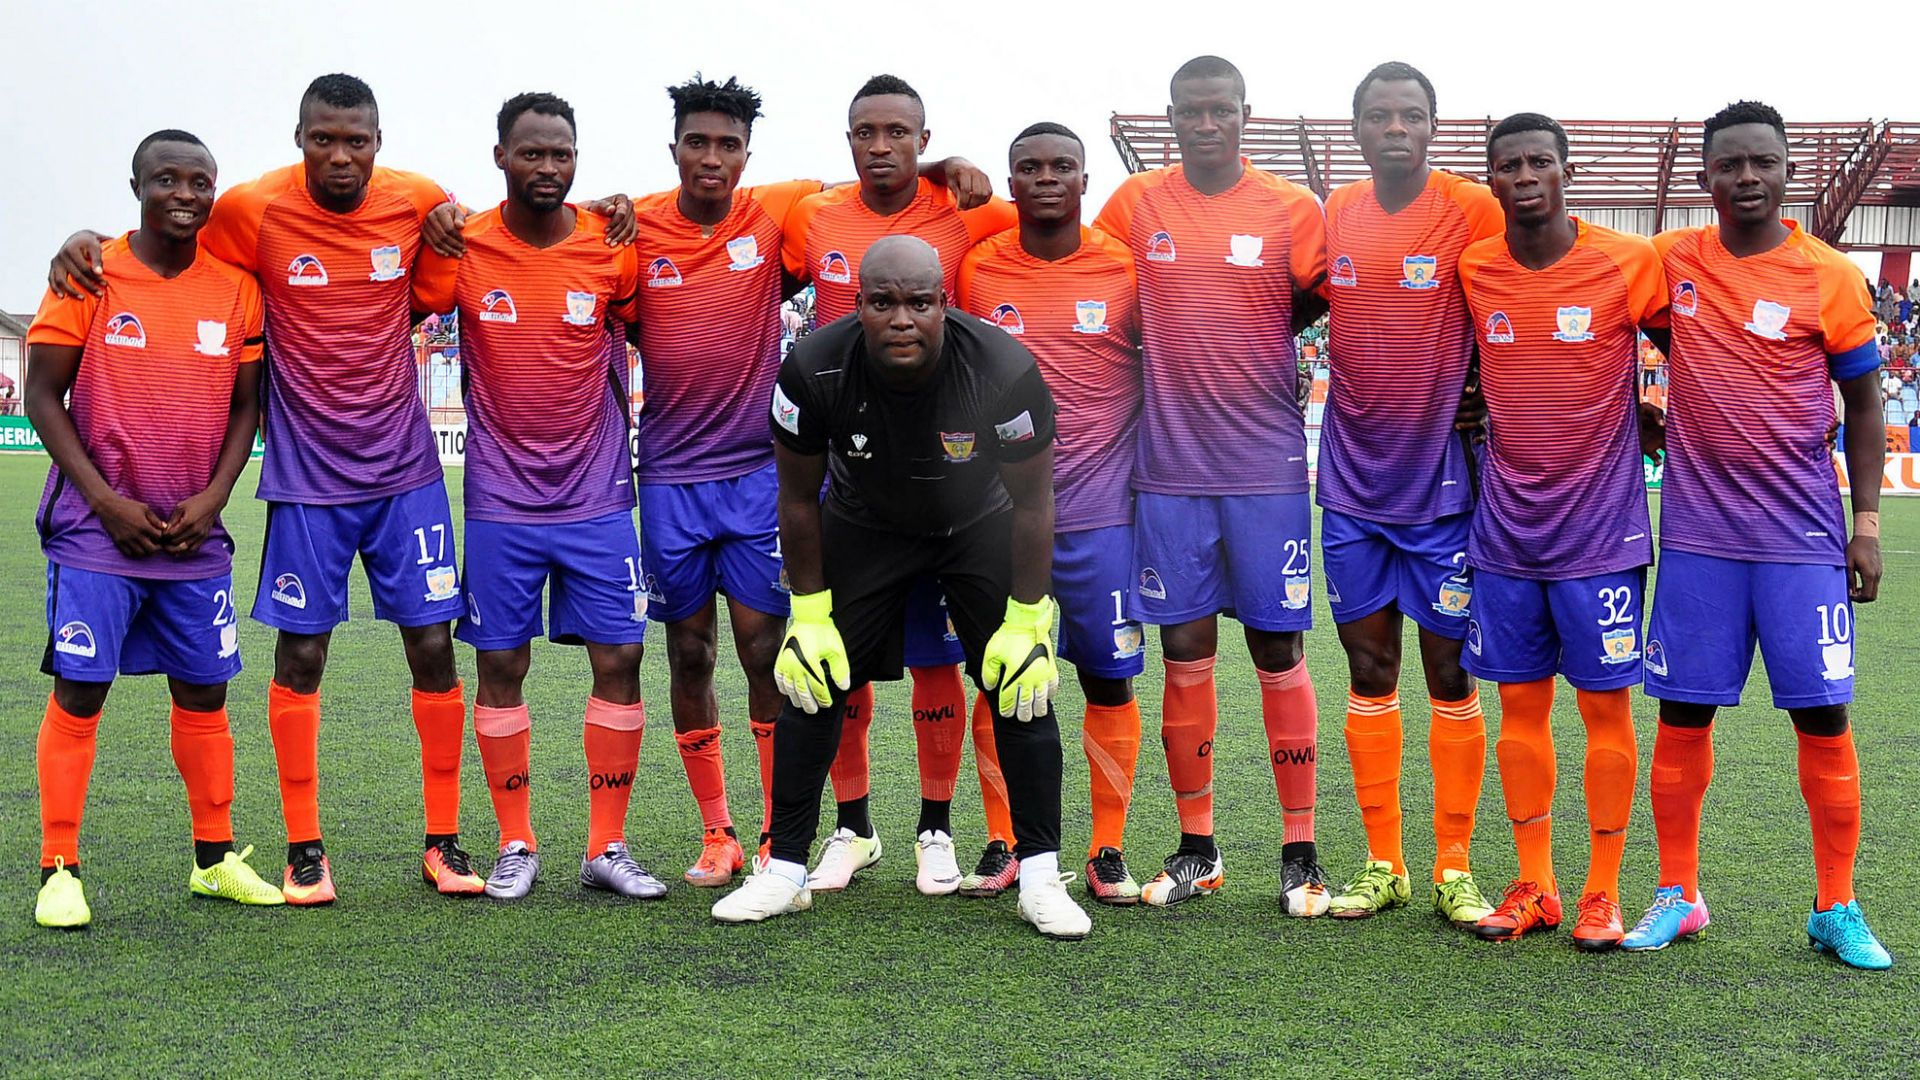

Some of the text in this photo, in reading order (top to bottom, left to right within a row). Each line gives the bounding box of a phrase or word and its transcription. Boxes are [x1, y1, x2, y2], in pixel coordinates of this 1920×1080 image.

[414, 523, 445, 565] 17
[1281, 538, 1310, 576] 25
[1597, 587, 1634, 626] 32
[1816, 602, 1851, 645] 10
[913, 704, 955, 722] OWU
[1274, 745, 1315, 765] OWU
[590, 771, 633, 789] OWU
